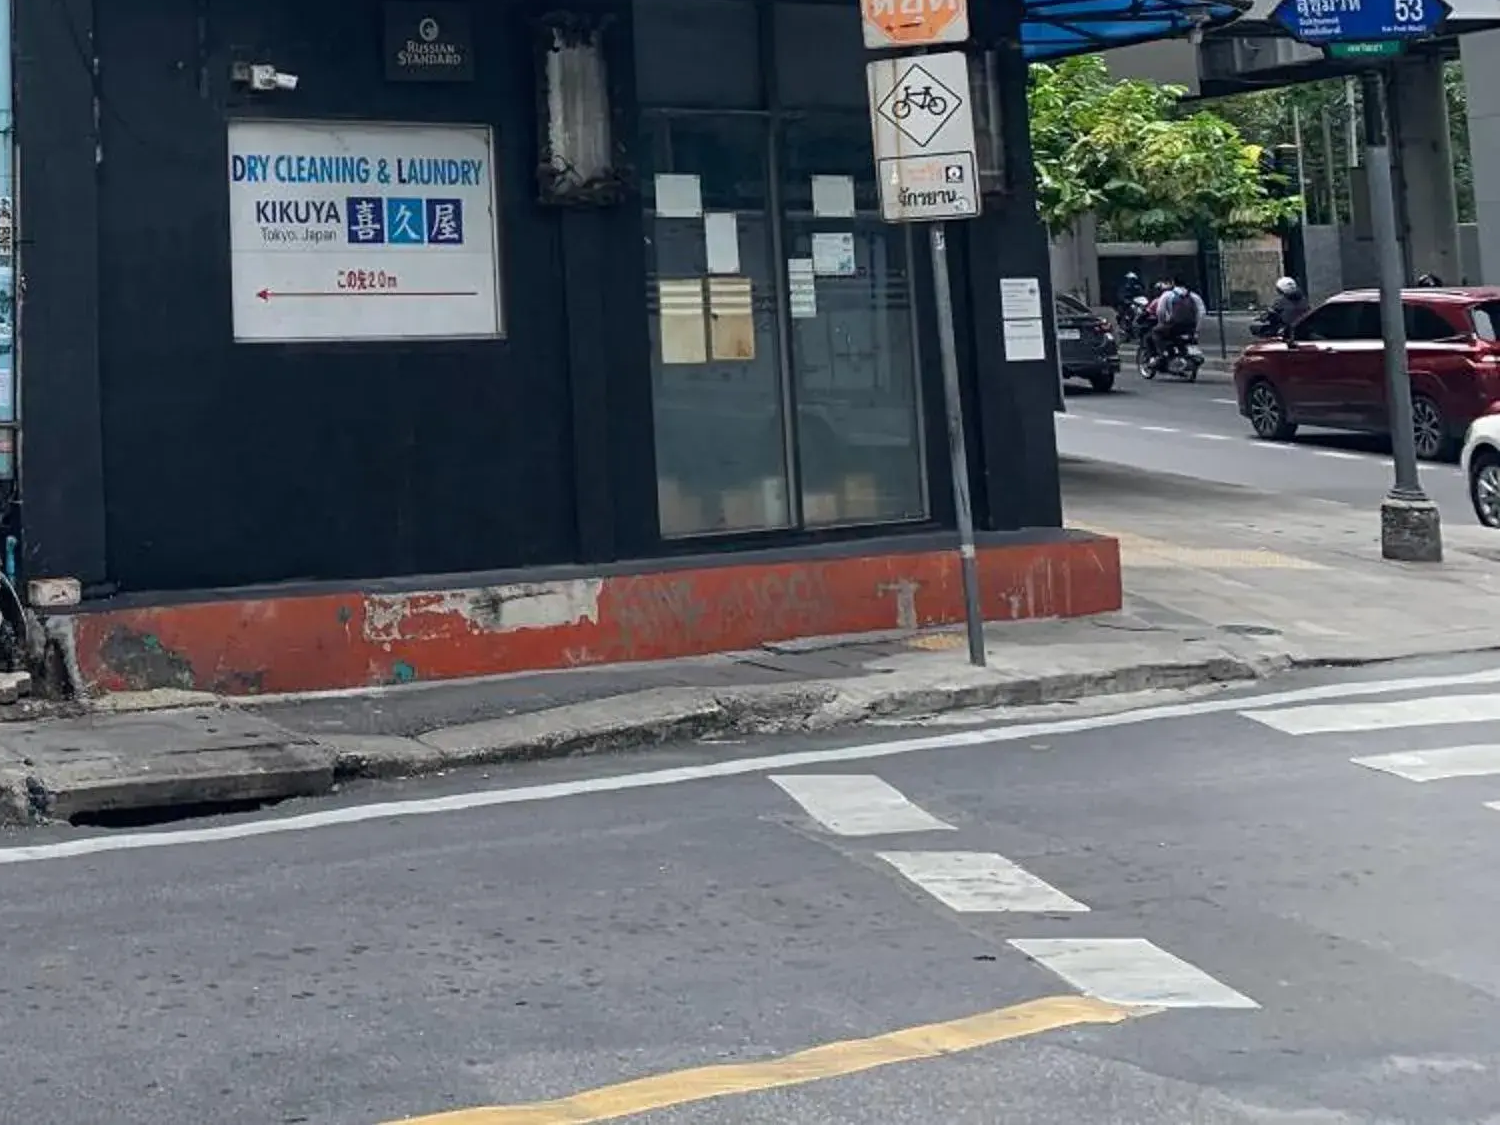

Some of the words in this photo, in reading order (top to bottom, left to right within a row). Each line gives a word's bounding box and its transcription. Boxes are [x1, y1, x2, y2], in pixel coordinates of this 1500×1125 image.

[406, 40, 455, 54] RUSSIAN
[397, 50, 462, 66] STANDARD
[232, 155, 270, 183] DRY
[274, 155, 370, 184] CLEANING
[377, 158, 391, 185] &
[398, 158, 483, 187] LAUNDRY
[256, 200, 341, 224] KIKUYA
[350, 201, 459, 241] 喜久屋
[303, 227, 337, 244] Japan
